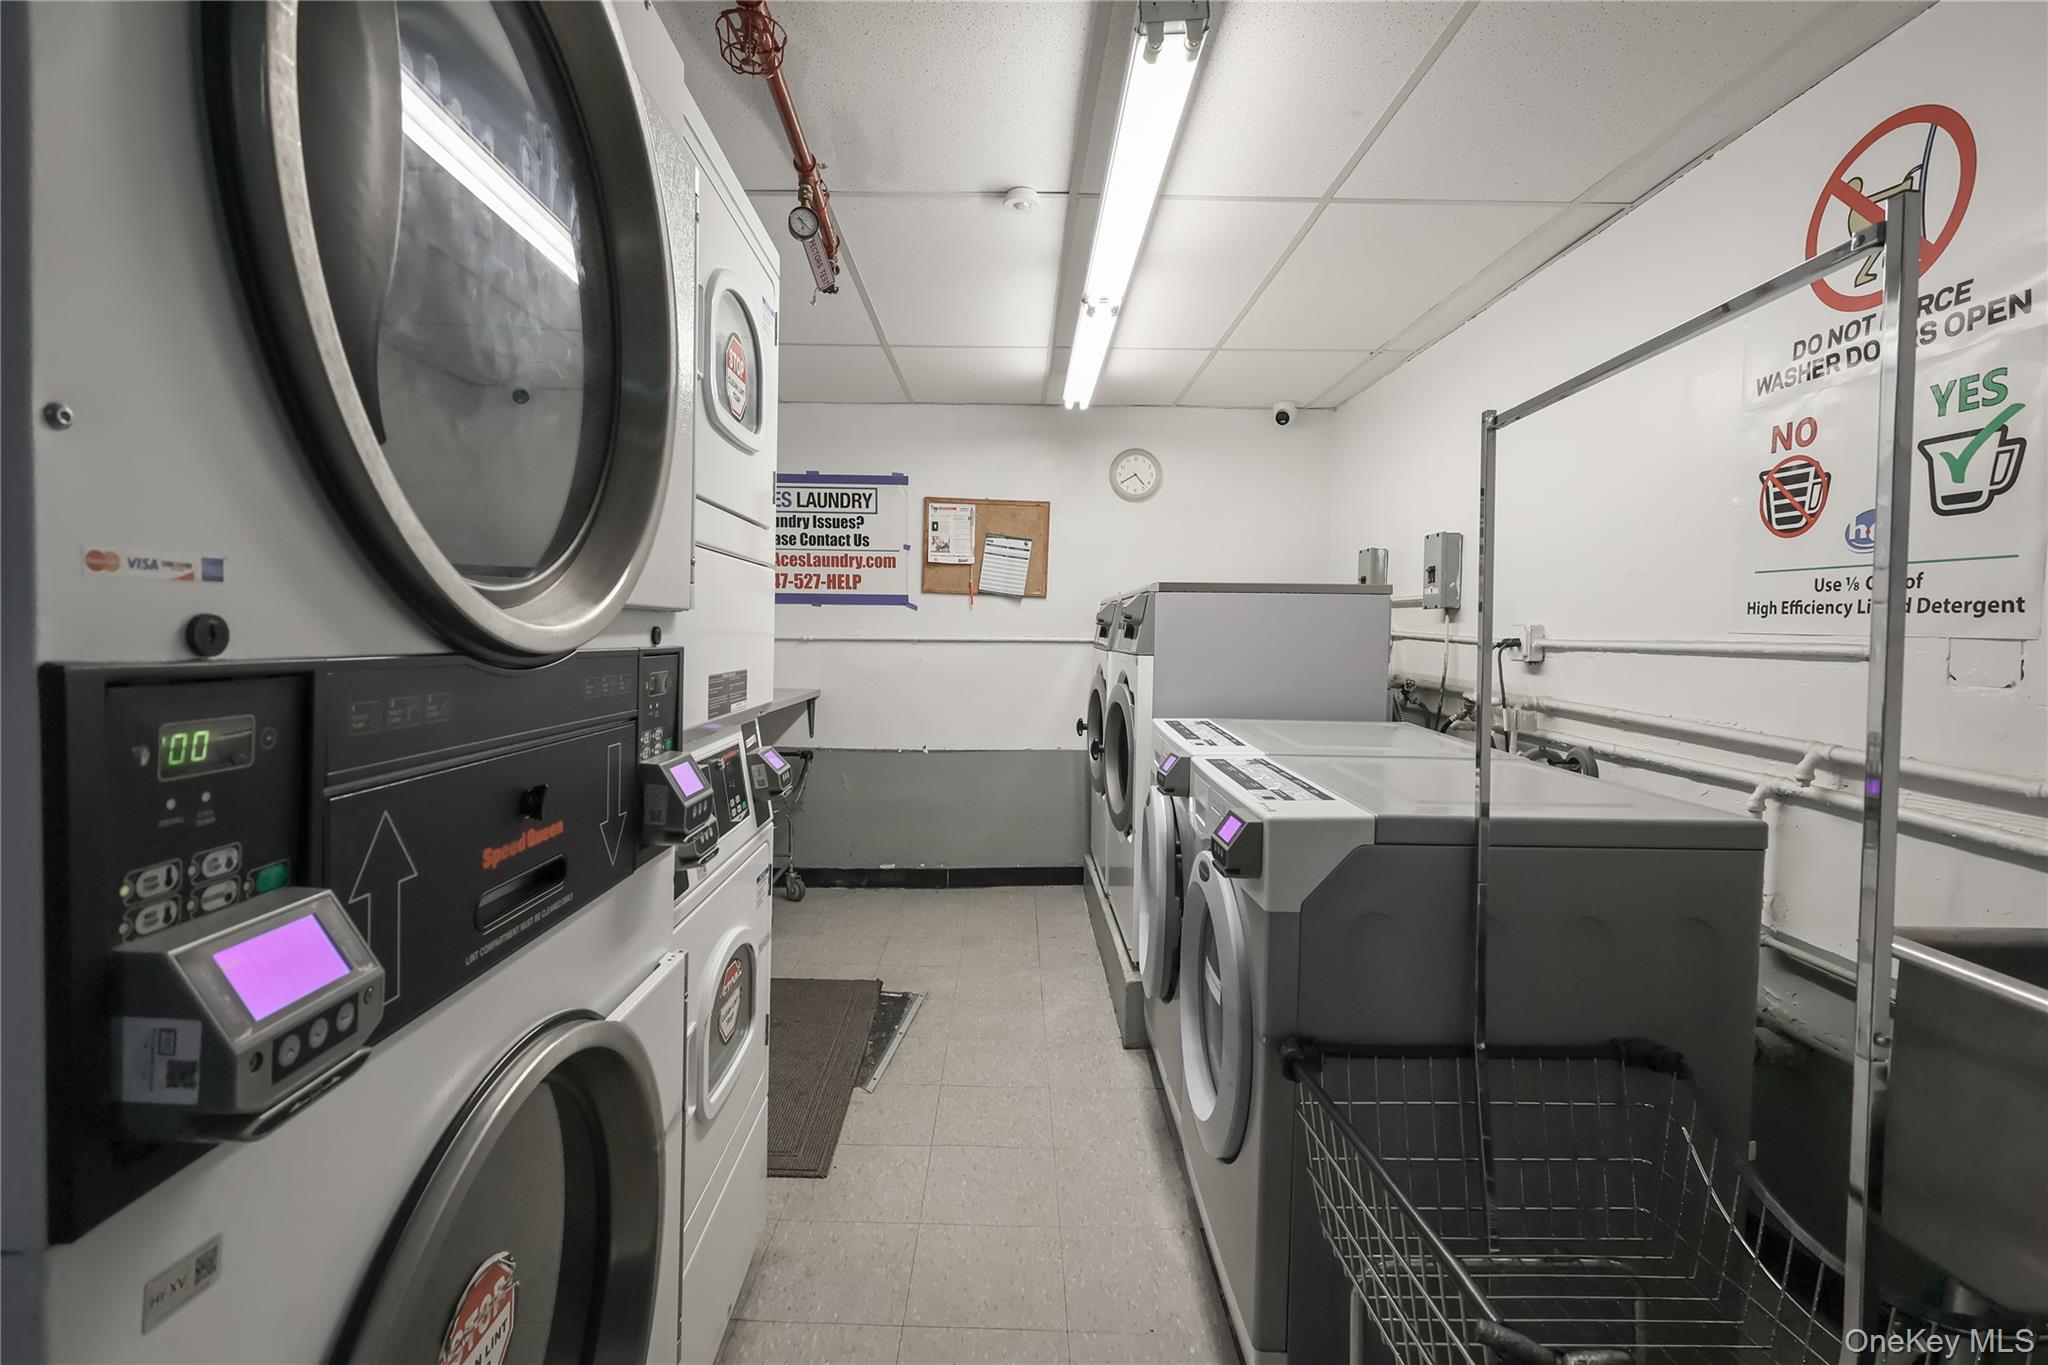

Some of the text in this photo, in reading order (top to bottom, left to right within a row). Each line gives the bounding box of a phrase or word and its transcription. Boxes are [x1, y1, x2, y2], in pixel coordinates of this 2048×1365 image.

[1756, 289, 2032, 397] WASHER DOS OPEN
[1792, 333, 1823, 361] DO
[1827, 313, 1877, 349] NOT
[1930, 367, 2009, 417] YES
[1771, 417, 1818, 454] NO
[796, 491, 873, 509] LAUNDRY
[812, 515, 864, 529] Issues?
[800, 532, 851, 546] Contact
[853, 533, 870, 547] Us
[127, 556, 159, 570] VISA
[1814, 577, 1842, 592] Use
[1906, 571, 1924, 590] of
[1747, 596, 2026, 618] High Efficiency Lid Detergent
[482, 820, 564, 869] Speed Queen
[485, 1318, 508, 1358] LINT
